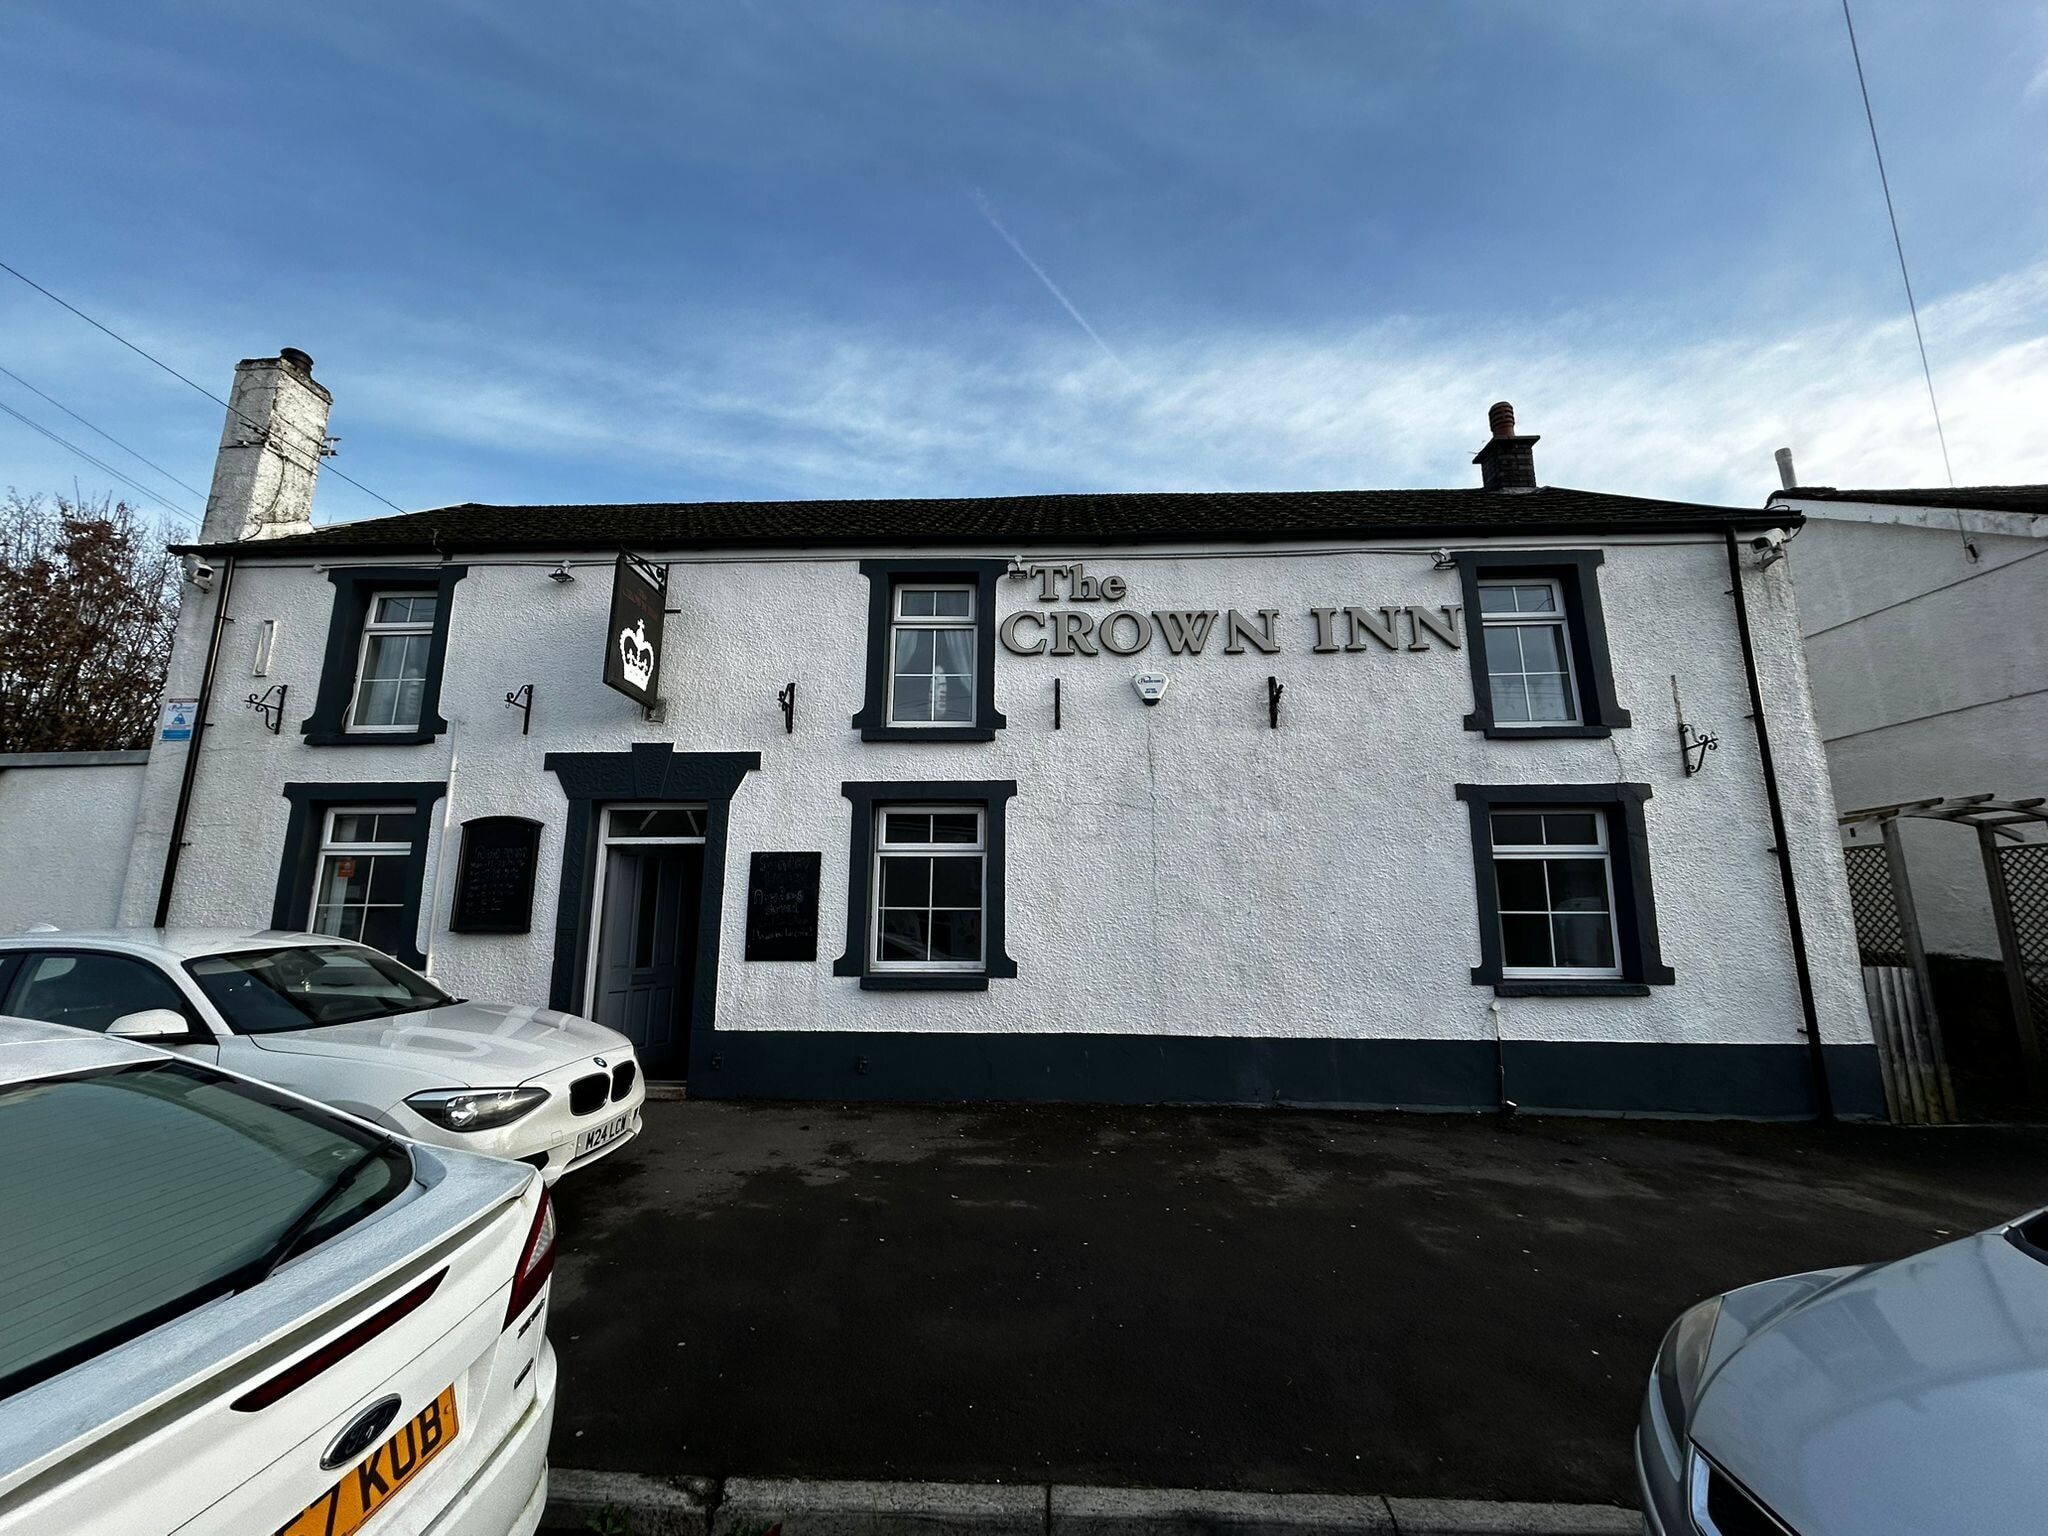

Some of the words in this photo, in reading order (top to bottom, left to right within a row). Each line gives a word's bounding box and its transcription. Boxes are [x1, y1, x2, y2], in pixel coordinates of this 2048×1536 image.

[1031, 563, 1126, 601] The
[1000, 609, 1281, 656] CROWN
[1310, 604, 1462, 652] INN
[358, 1398, 443, 1513] KUB
